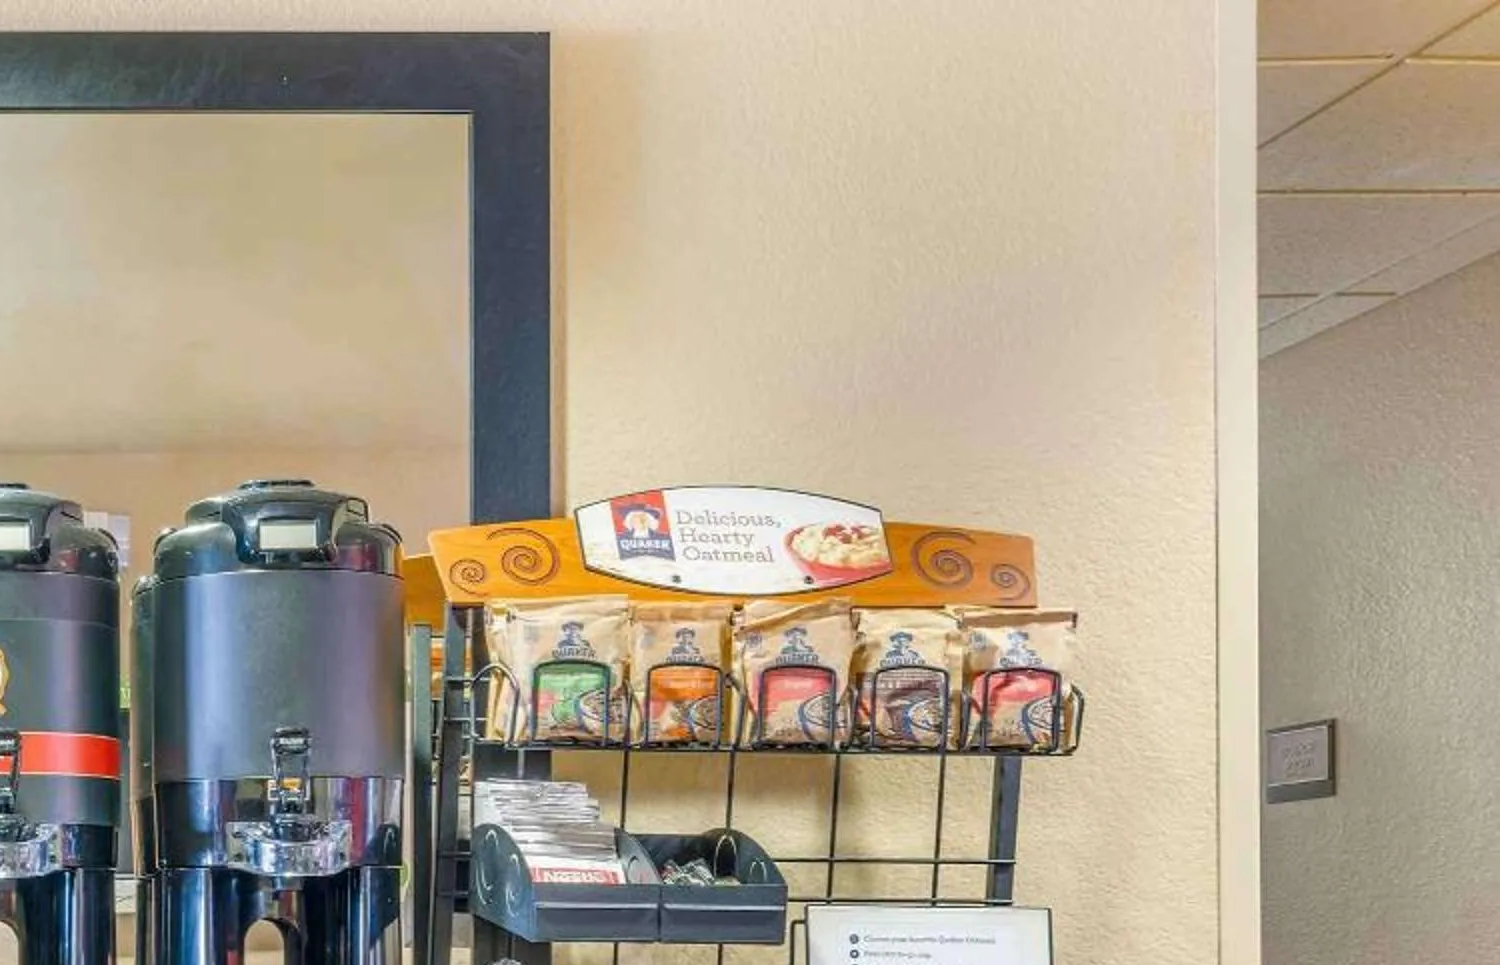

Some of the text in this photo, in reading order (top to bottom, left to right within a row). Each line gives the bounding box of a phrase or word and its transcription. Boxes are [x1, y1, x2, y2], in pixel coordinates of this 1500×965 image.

[676, 509, 782, 528] Delicious,
[620, 539, 671, 550] QUAKER
[679, 527, 755, 547] Hearty
[683, 546, 775, 563] Oatmeal
